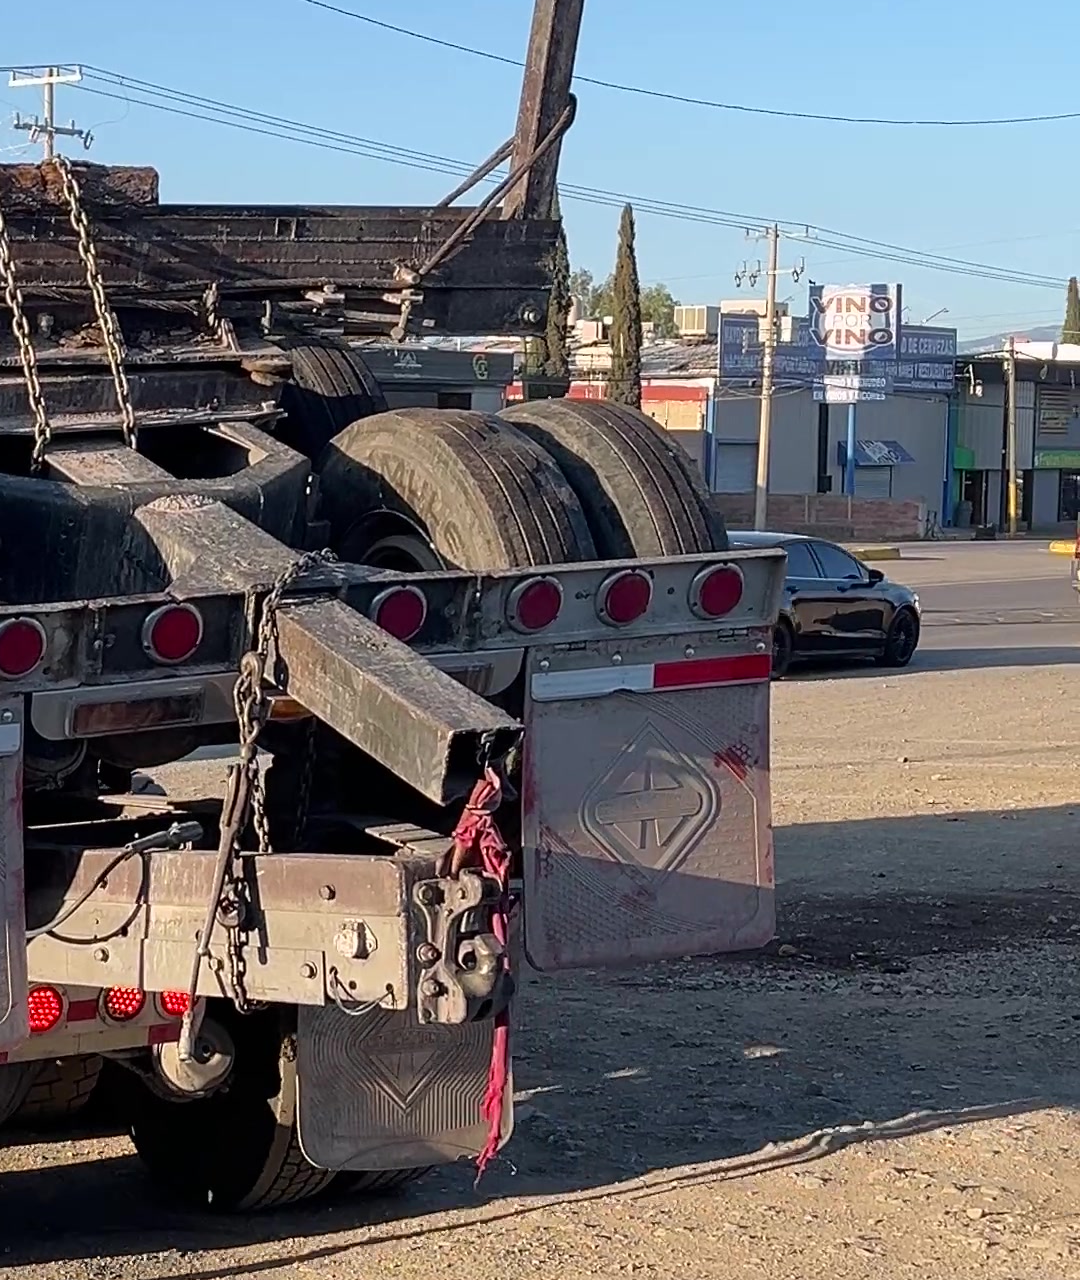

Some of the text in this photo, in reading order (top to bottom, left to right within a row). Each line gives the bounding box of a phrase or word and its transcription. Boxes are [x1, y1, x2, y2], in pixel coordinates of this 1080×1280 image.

[811, 297, 893, 313] VINO
[833, 314, 871, 328] POR
[810, 328, 893, 345] VINO
